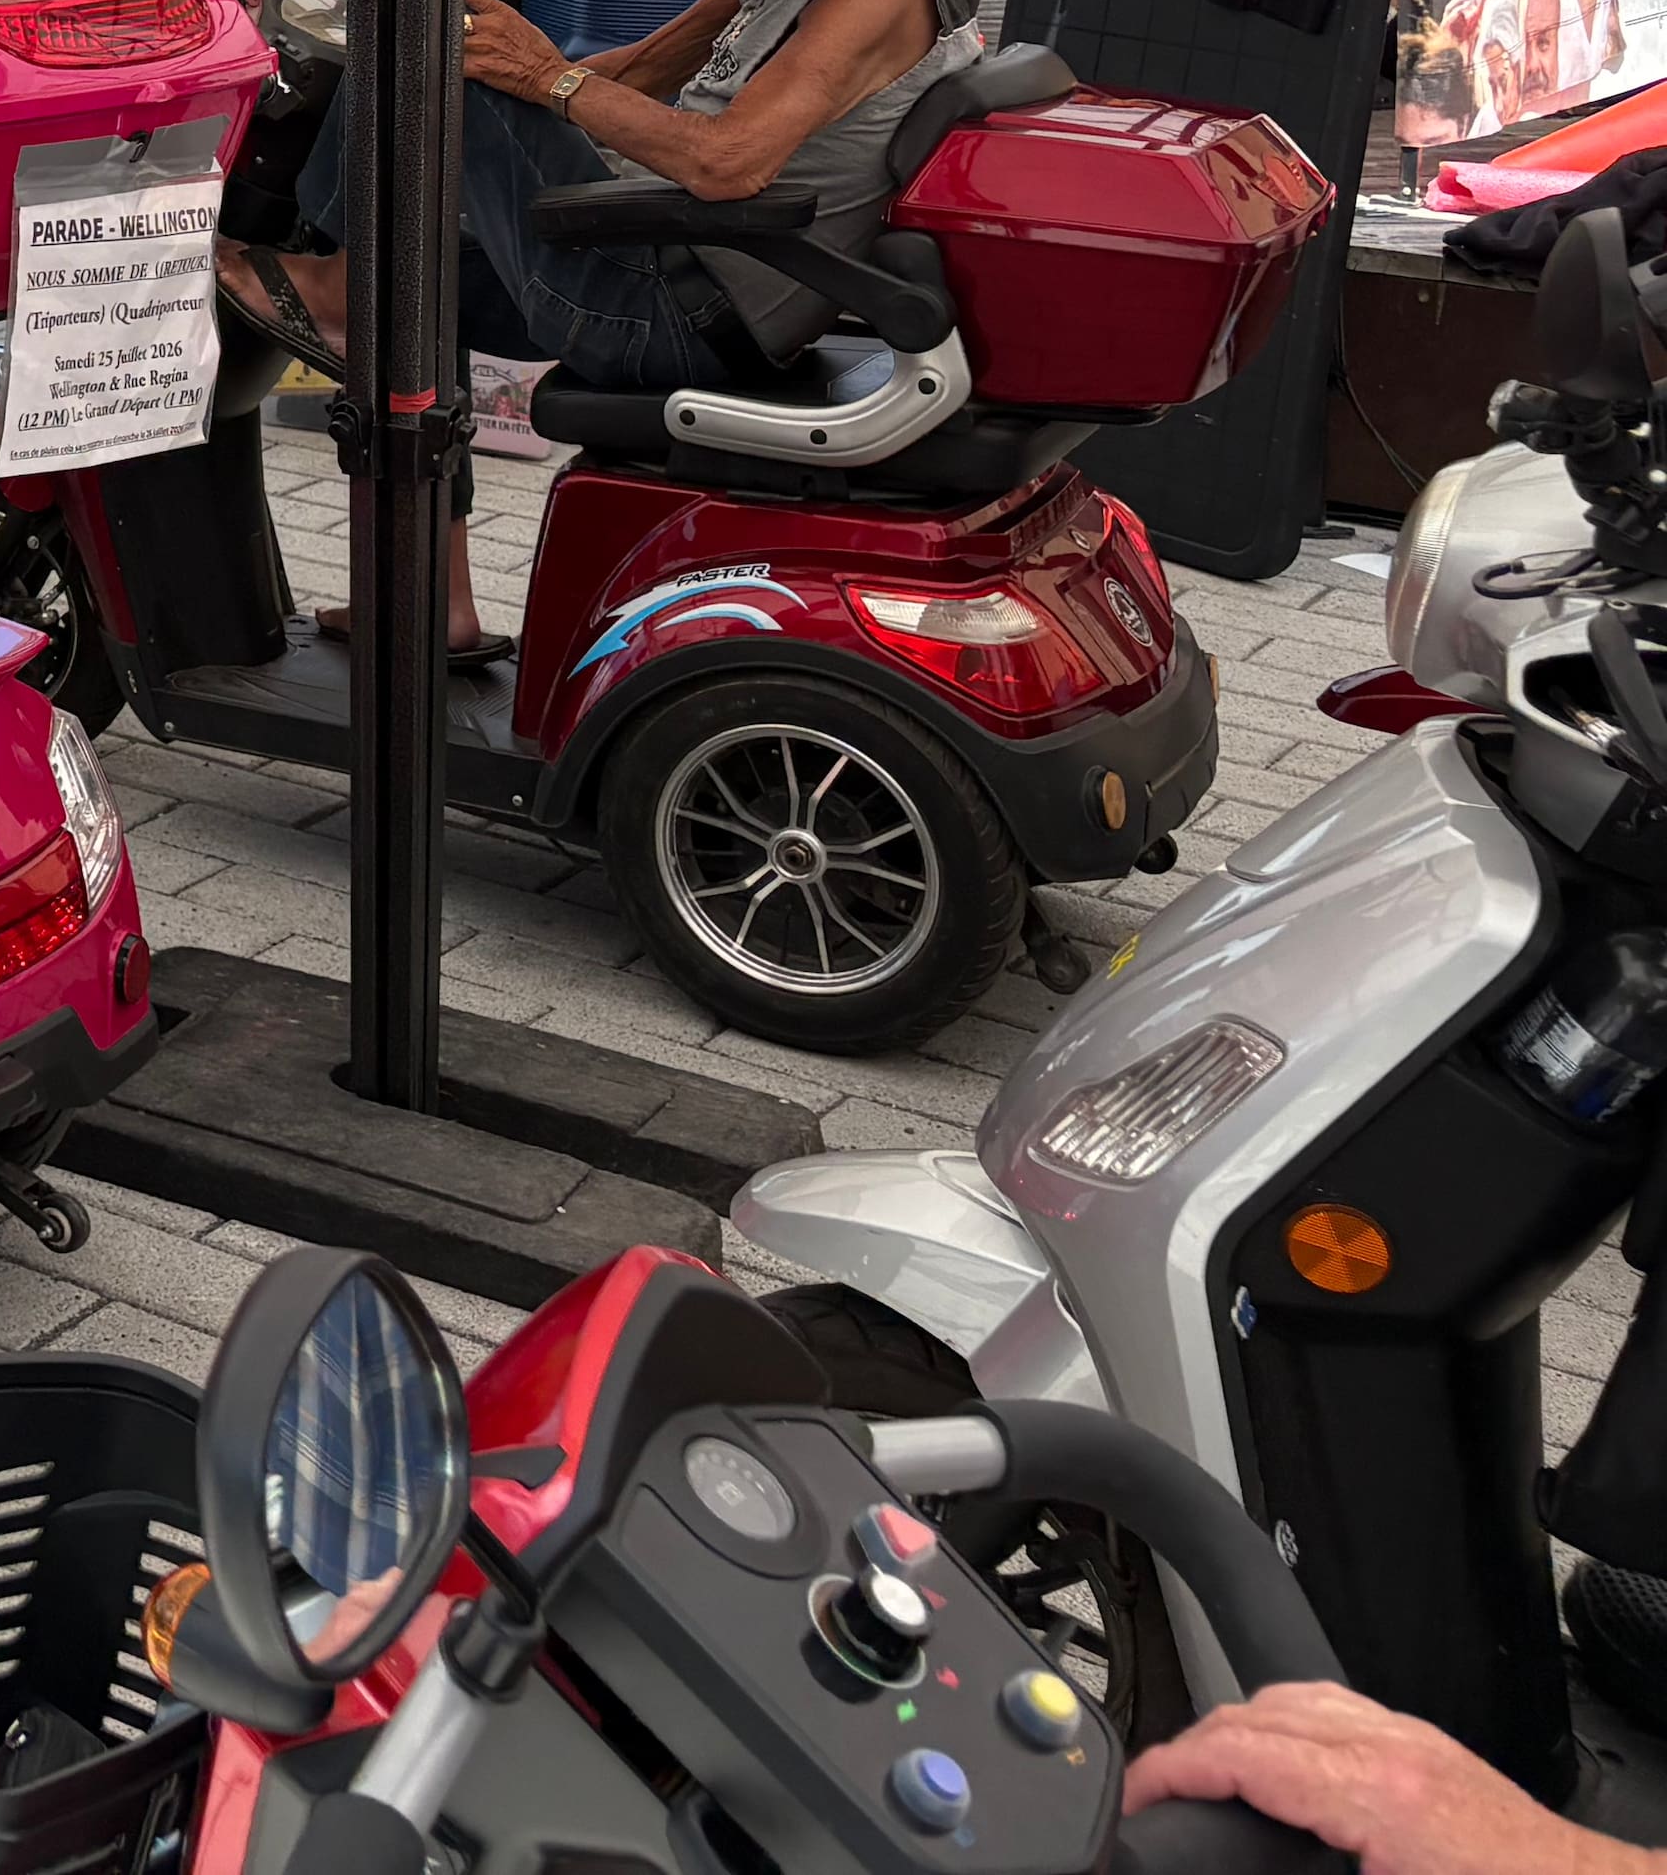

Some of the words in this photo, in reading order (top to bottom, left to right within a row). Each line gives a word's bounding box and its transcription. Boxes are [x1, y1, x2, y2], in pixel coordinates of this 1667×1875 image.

[32, 217, 103, 244] PARADE
[119, 207, 216, 238] WELLINGTON
[27, 269, 66, 289] NOUS
[71, 265, 125, 285] SOMME
[129, 262, 148, 279] DE
[26, 304, 106, 335] (Triporteurs)
[54, 351, 95, 372] Samedi
[98, 352, 113, 367] 25
[116, 346, 147, 369] Juillet
[150, 340, 183, 359] 2026
[49, 379, 105, 400] Wellington
[109, 376, 121, 391] &
[124, 374, 146, 389] Rue
[149, 368, 189, 389] Regina
[18, 412, 39, 431] (12
[43, 408, 69, 428] PM)
[72, 405, 83, 423] Le
[85, 400, 118, 421] Grand
[120, 392, 161, 416] Départ
[164, 391, 176, 410] (1
[676, 564, 771, 587] FASTER
